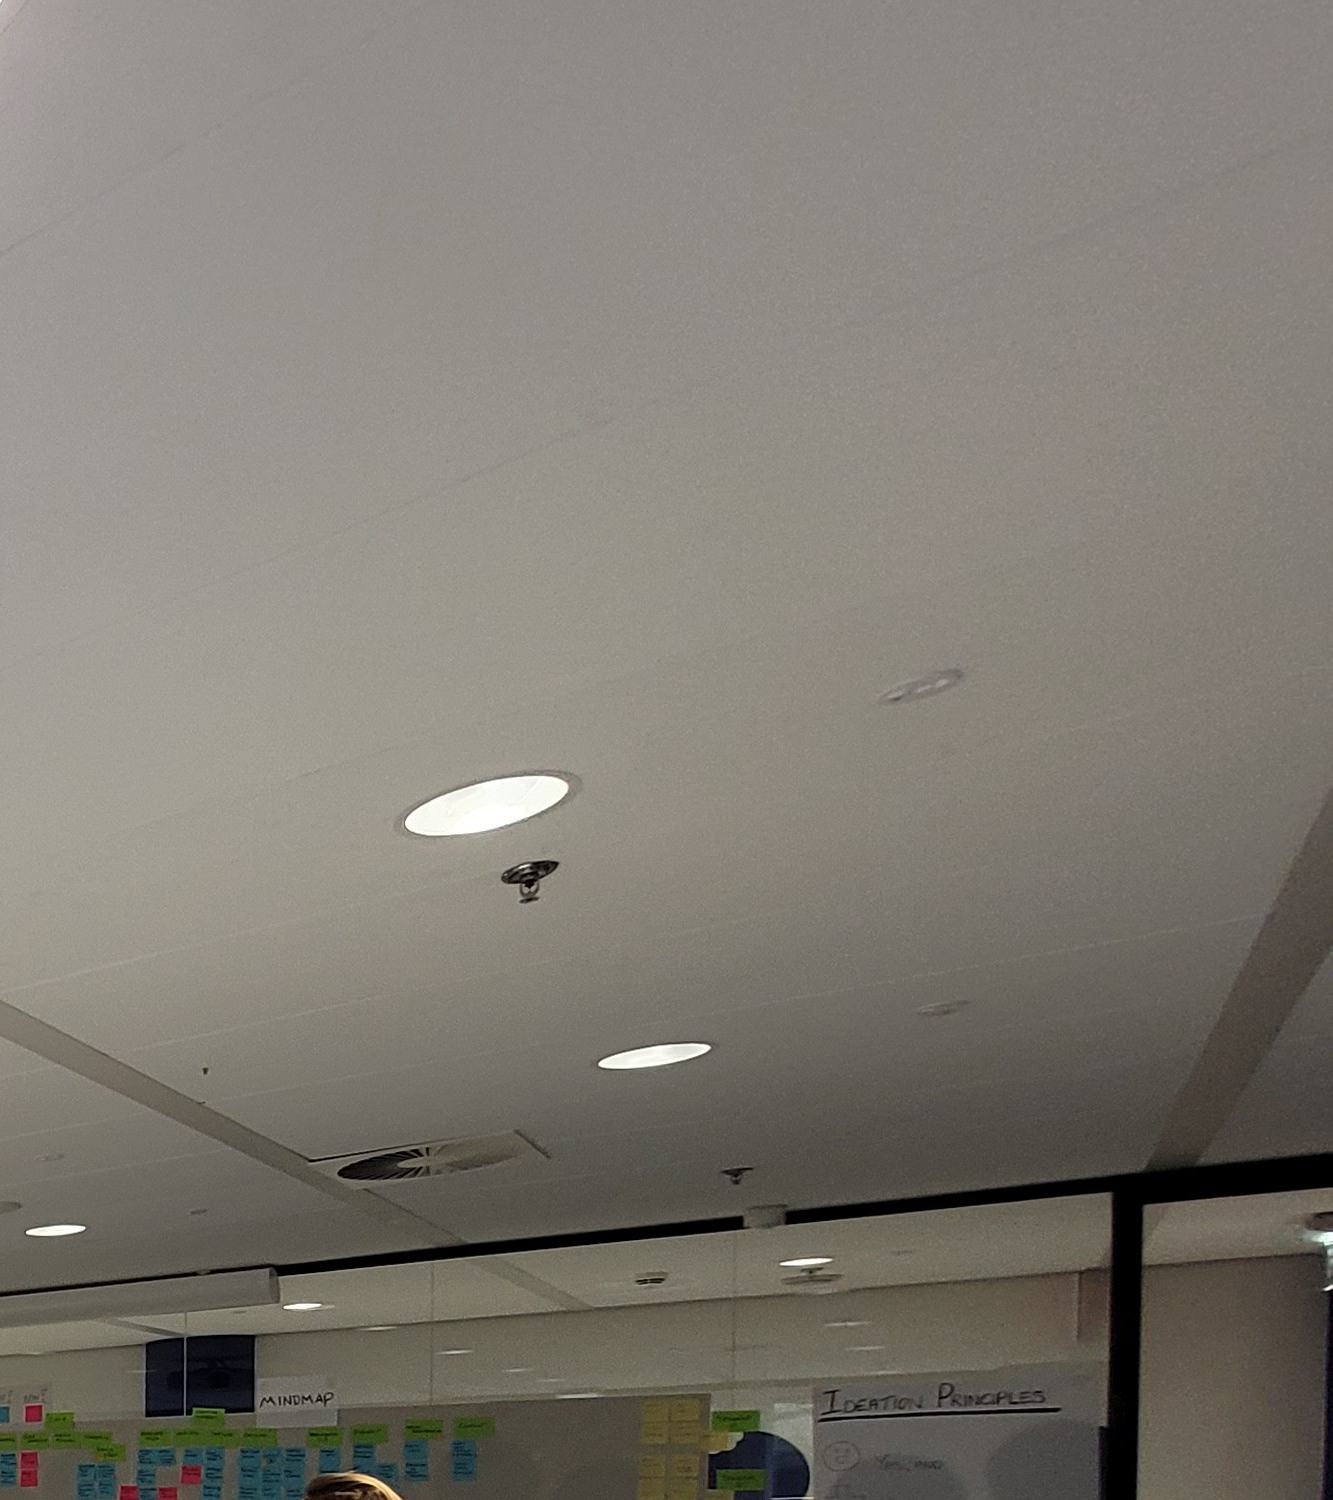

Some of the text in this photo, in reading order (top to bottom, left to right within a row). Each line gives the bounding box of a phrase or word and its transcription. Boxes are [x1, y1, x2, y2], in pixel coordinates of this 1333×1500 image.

[259, 1391, 335, 1409] MINDMAP
[821, 1382, 1047, 1416] IDEATION PRINCIPLES
